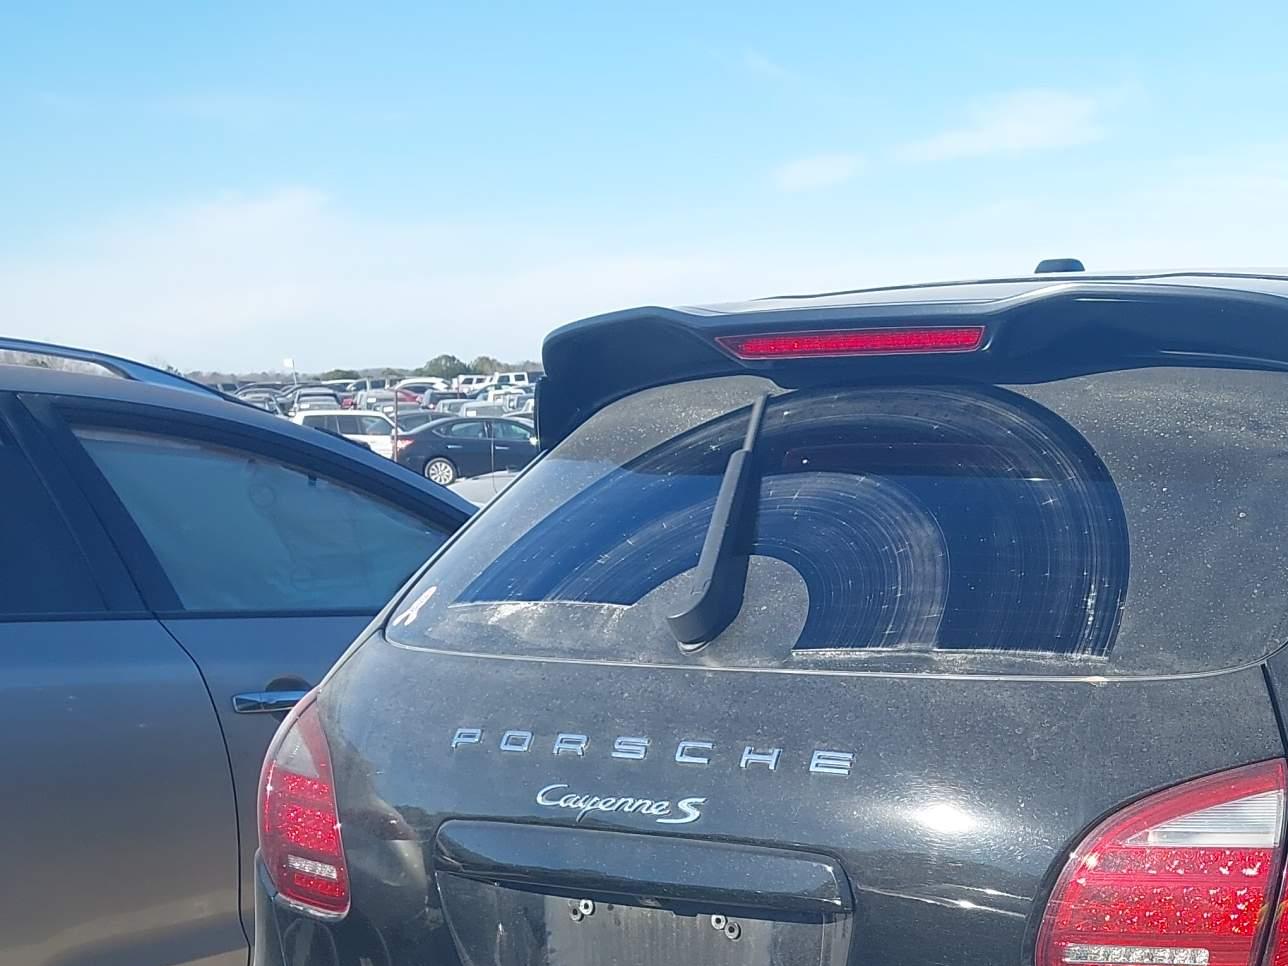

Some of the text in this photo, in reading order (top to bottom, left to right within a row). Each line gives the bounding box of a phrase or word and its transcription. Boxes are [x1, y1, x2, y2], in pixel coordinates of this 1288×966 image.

[452, 727, 856, 776] PORSCHE
[536, 783, 707, 824] Cayenne S
